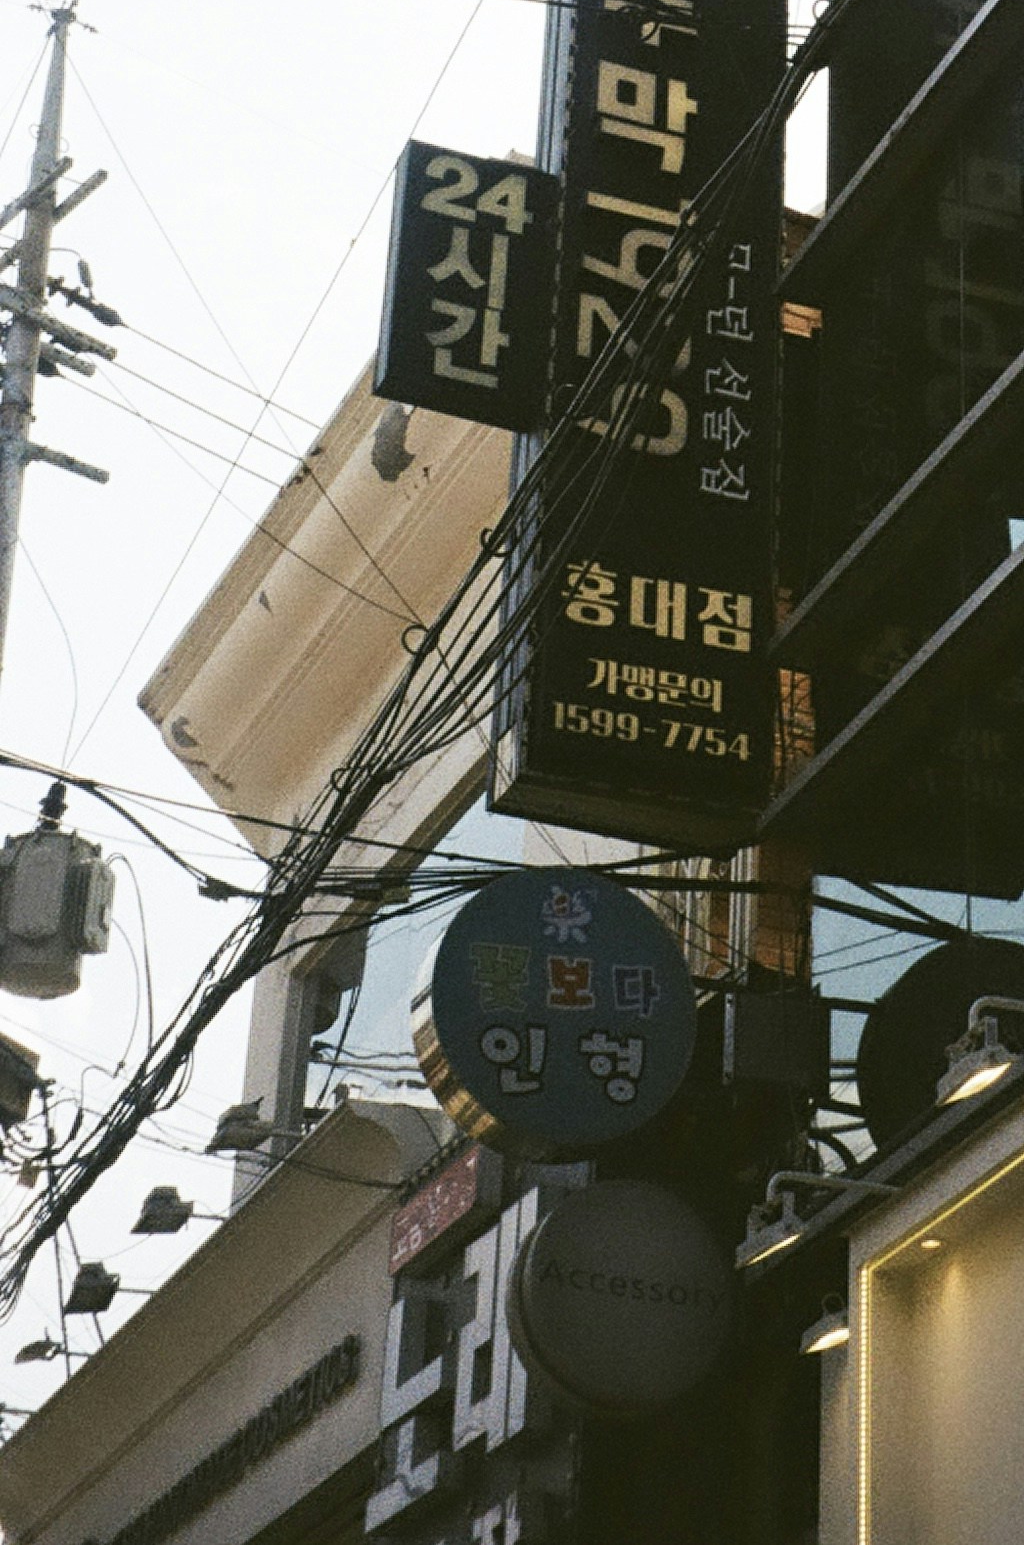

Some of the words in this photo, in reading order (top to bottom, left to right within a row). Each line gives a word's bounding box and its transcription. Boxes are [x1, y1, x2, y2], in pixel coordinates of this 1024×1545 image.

[700, 357, 753, 501] 선술집
[561, 559, 752, 653] 홍대점
[587, 656, 723, 714] 가맹문의
[553, 700, 750, 762] 1599-7754
[478, 1022, 646, 1106] 인형
[539, 1259, 725, 1317] Accessory
